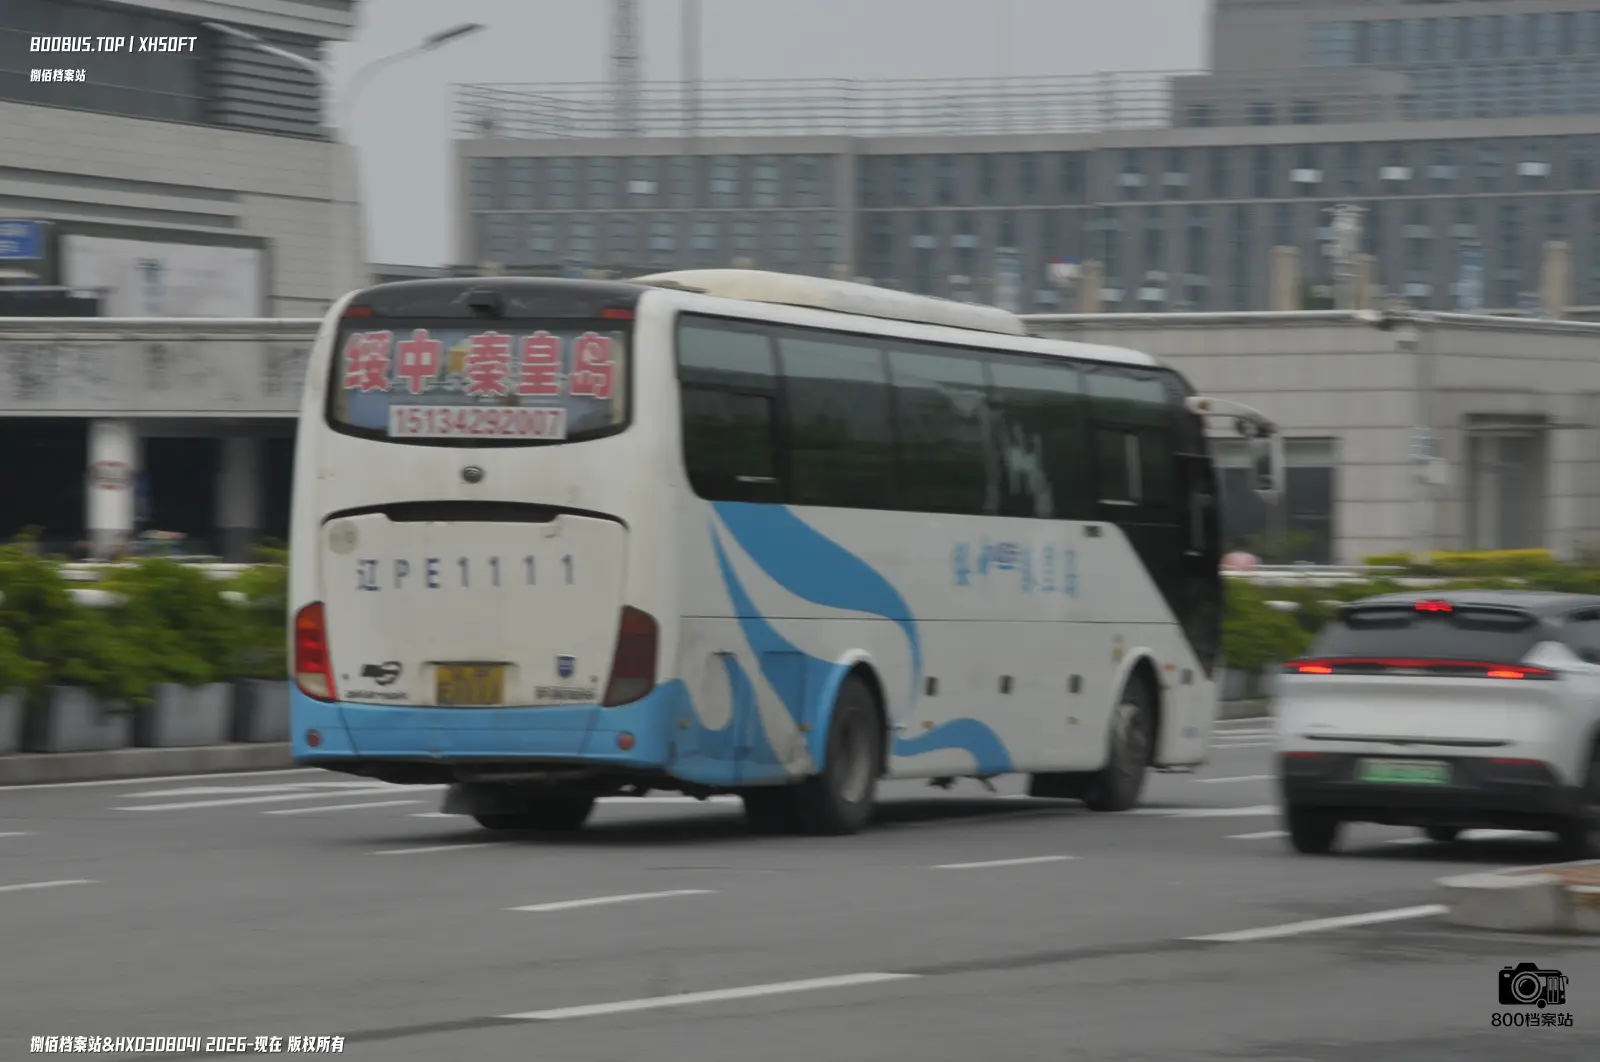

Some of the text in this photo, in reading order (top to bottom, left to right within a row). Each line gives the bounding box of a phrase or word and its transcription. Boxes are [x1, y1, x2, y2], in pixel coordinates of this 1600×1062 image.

[344, 329, 615, 399] 绥中 秦皇岛
